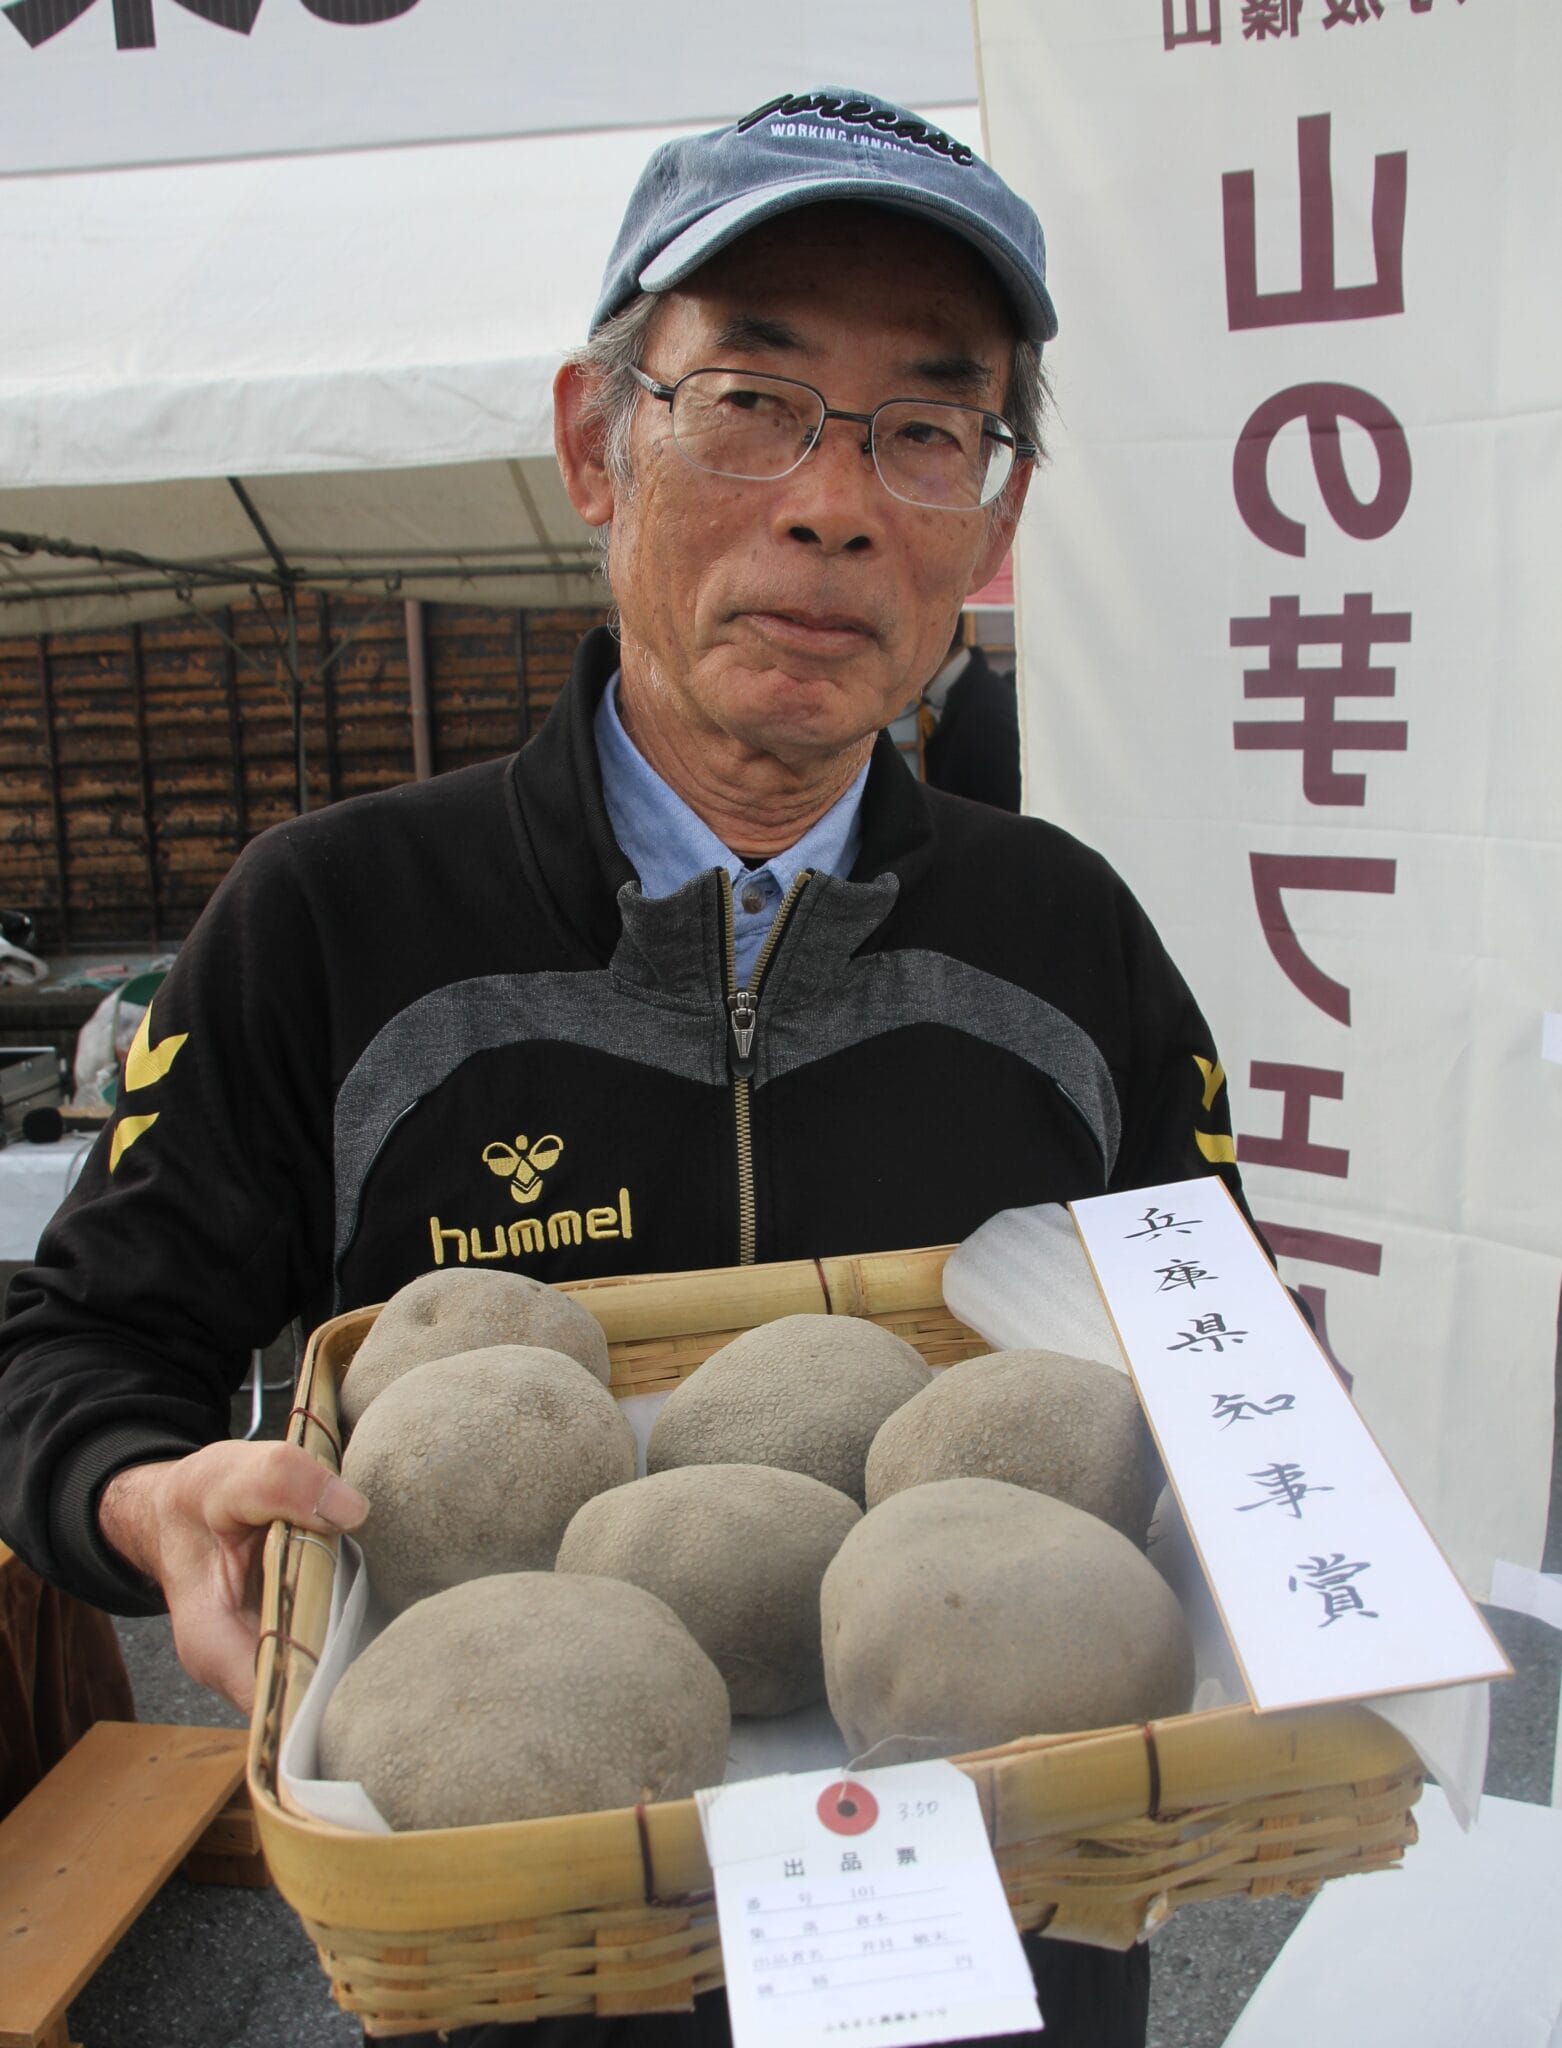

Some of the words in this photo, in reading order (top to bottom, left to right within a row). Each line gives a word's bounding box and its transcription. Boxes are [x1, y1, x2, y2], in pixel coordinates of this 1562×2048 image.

[770, 122, 848, 142] WORKING
[430, 1187, 633, 1265] hummel
[1123, 1207, 1379, 1627] 兵庫県知事賞
[783, 1846, 917, 1878] 出品票
